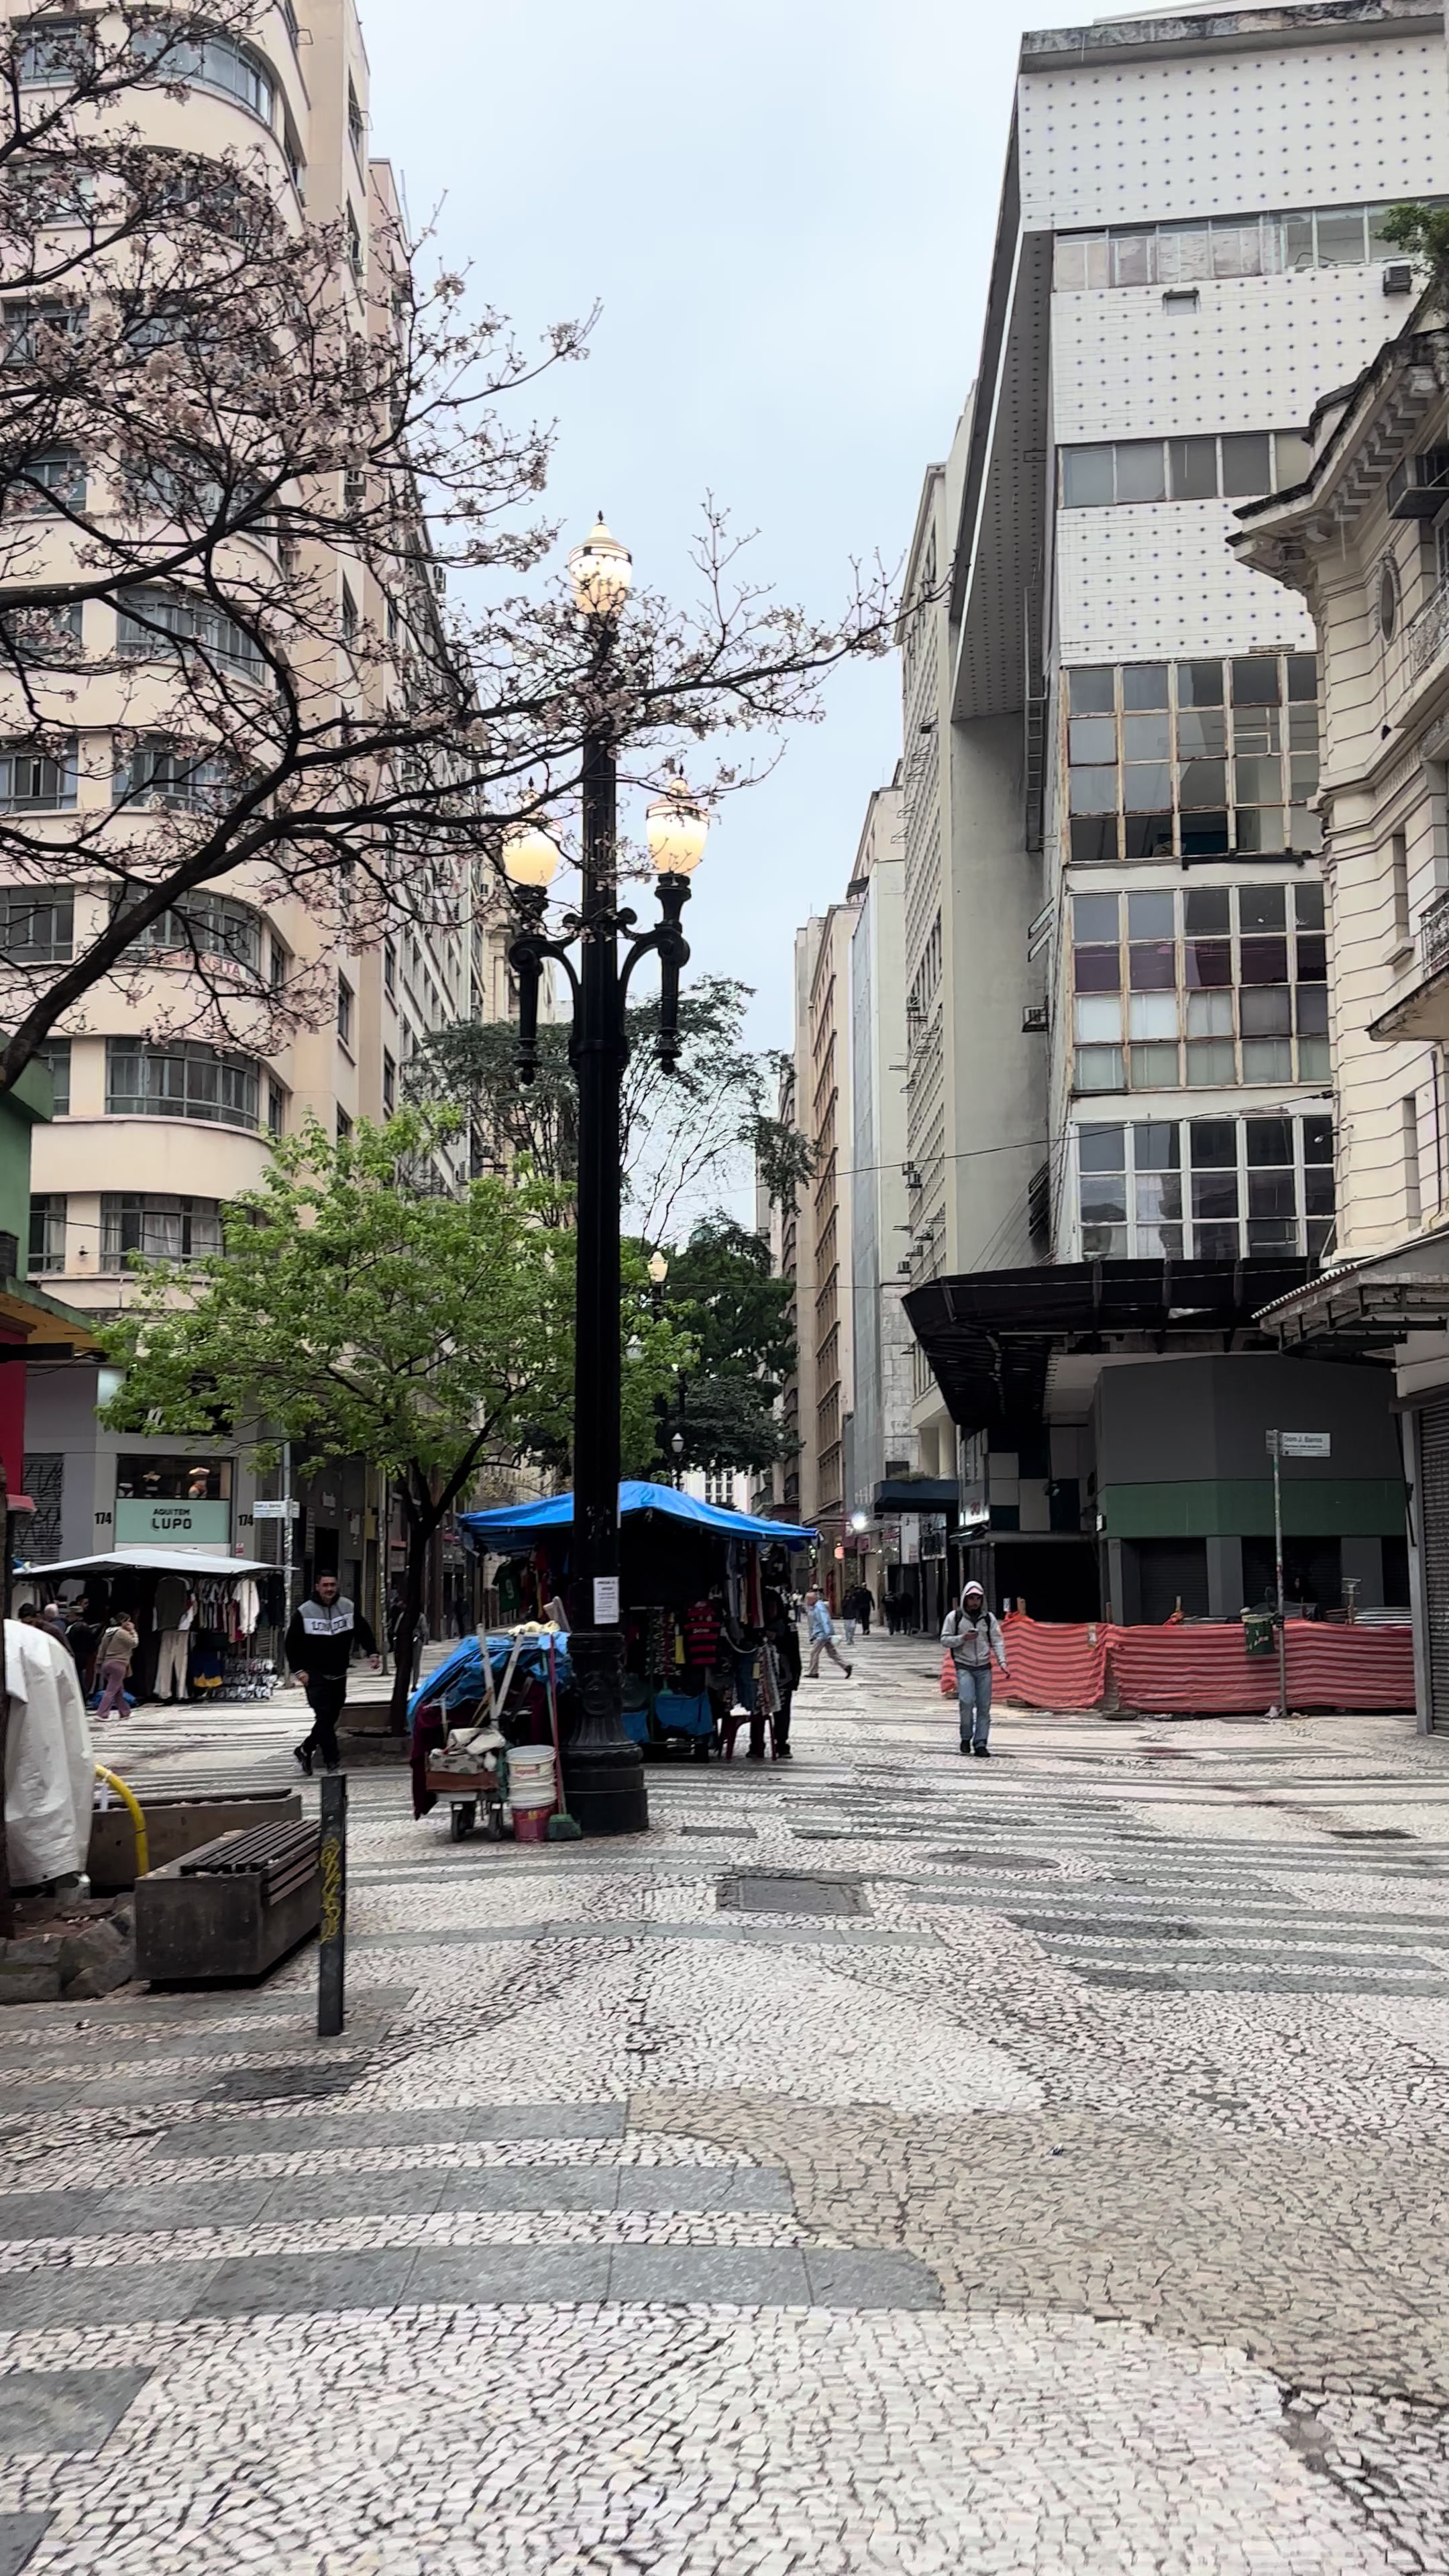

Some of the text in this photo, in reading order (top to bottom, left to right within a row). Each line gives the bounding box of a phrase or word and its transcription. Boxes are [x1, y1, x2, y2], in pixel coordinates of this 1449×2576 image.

[94, 1512, 112, 1524] 174
[152, 1518, 192, 1529] LUPO
[237, 1514, 254, 1525] 174
